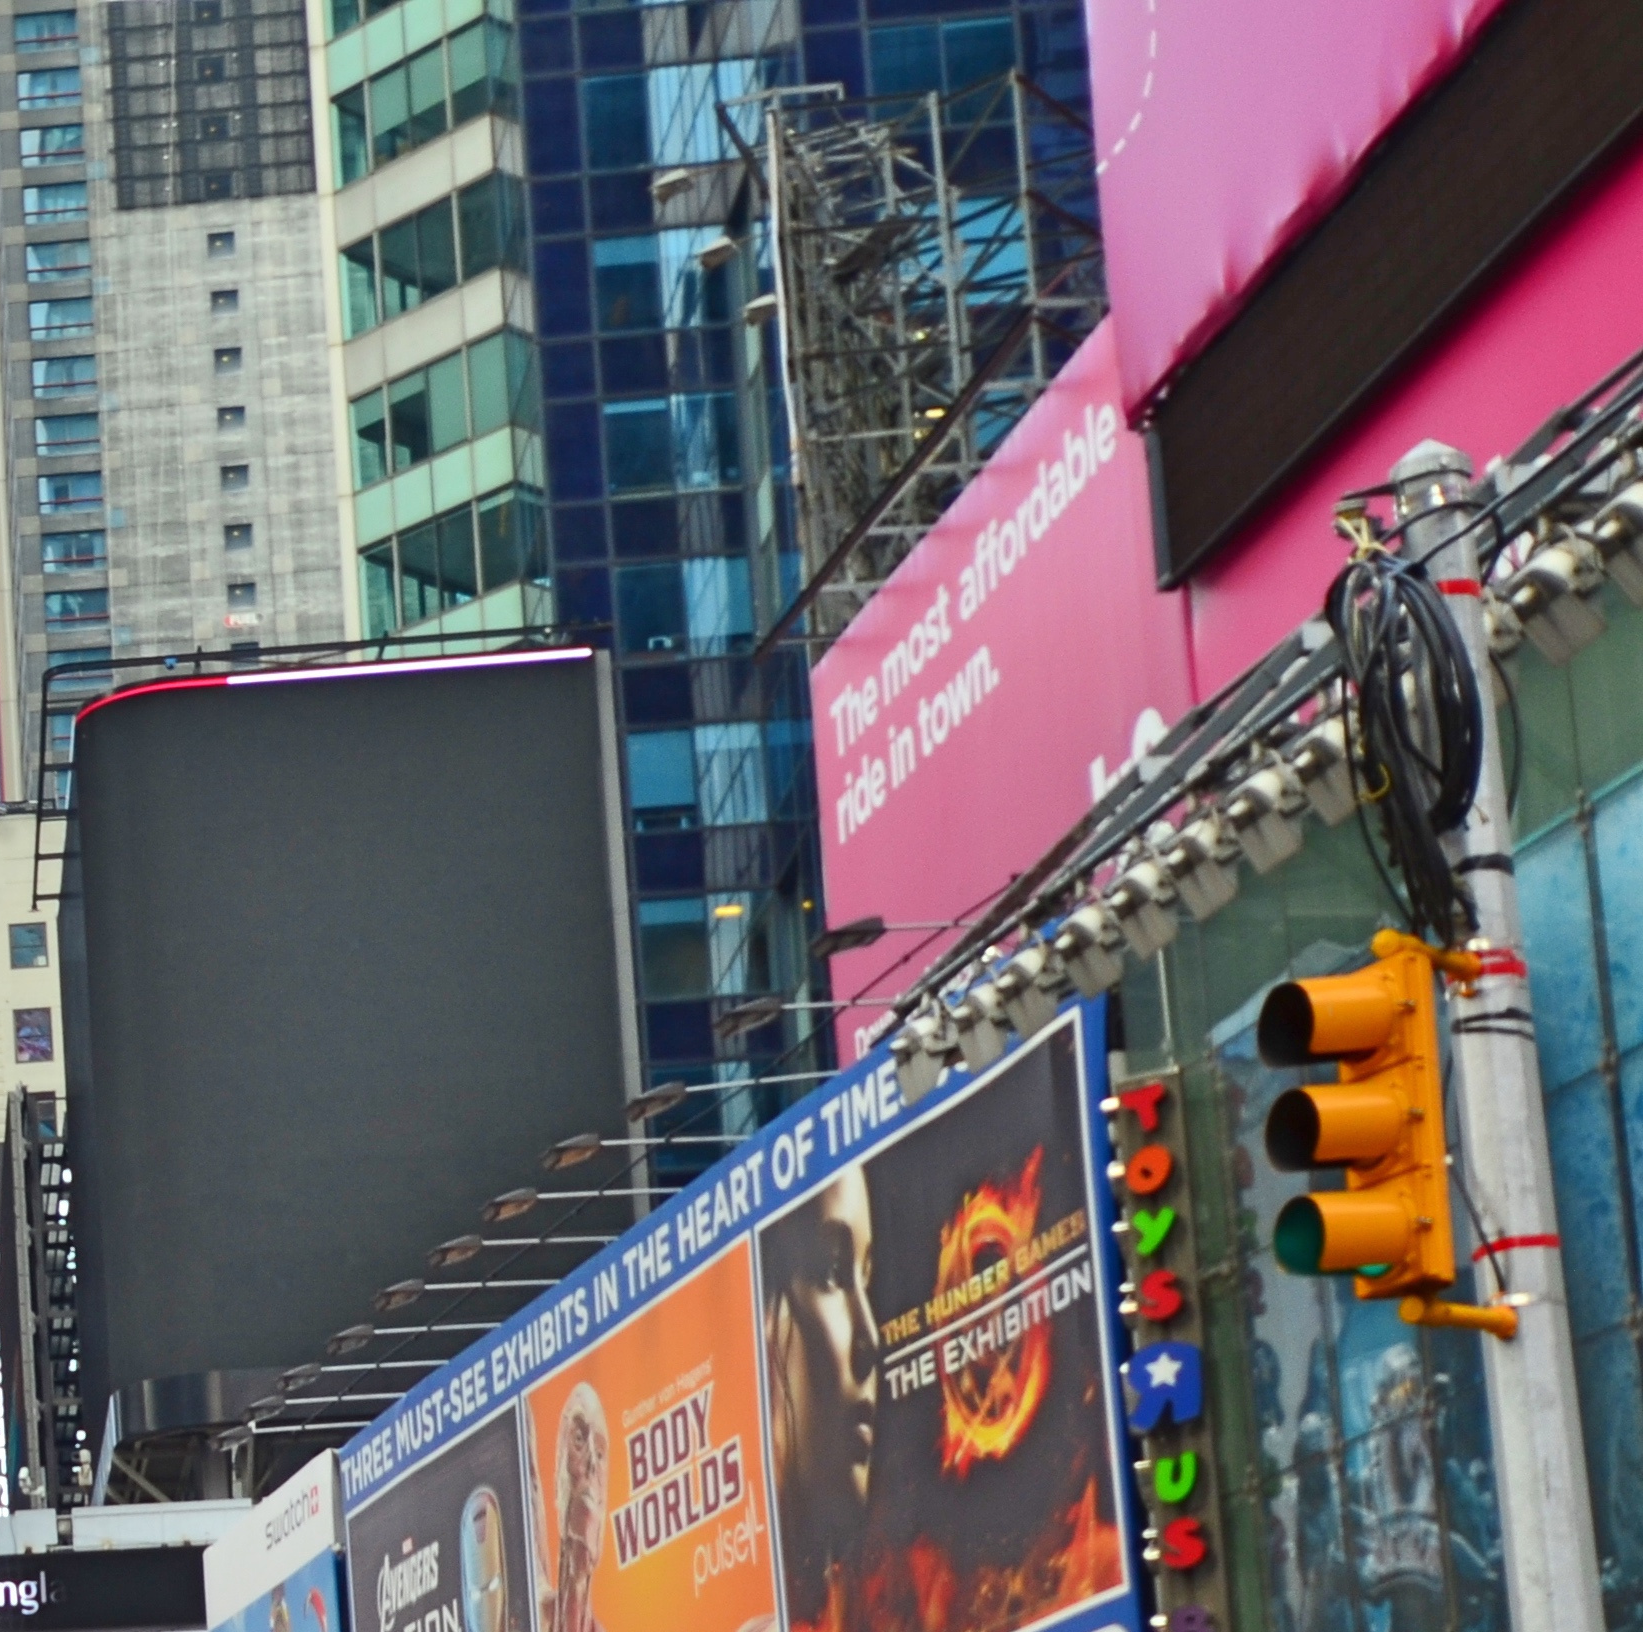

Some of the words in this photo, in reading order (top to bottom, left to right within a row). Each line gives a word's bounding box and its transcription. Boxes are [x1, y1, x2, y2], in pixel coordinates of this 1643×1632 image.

[830, 677, 878, 757] The
[883, 586, 952, 707] most
[959, 403, 1116, 622] affordable
[837, 757, 885, 844] ride
[890, 723, 916, 788] in
[918, 645, 1001, 757] town.
[340, 1427, 394, 1502] THREE
[396, 1358, 488, 1450] MUST-SEE
[491, 1289, 588, 1397] EXHIBITS
[594, 1263, 619, 1316] IN
[622, 1228, 673, 1300] THE
[676, 1152, 763, 1262] HEART
[771, 1118, 815, 1190] OF
[821, 1059, 905, 1156] TIME
[881, 1312, 920, 1347] THE
[925, 1259, 1011, 1327] HUNGER
[884, 1353, 936, 1400] THE
[944, 1261, 1094, 1376] EXHIBITION
[613, 1439, 741, 1566] WORLDS
[629, 1394, 712, 1491] BODY
[265, 1489, 310, 1550] swatch
[693, 1522, 752, 1598] pulse
